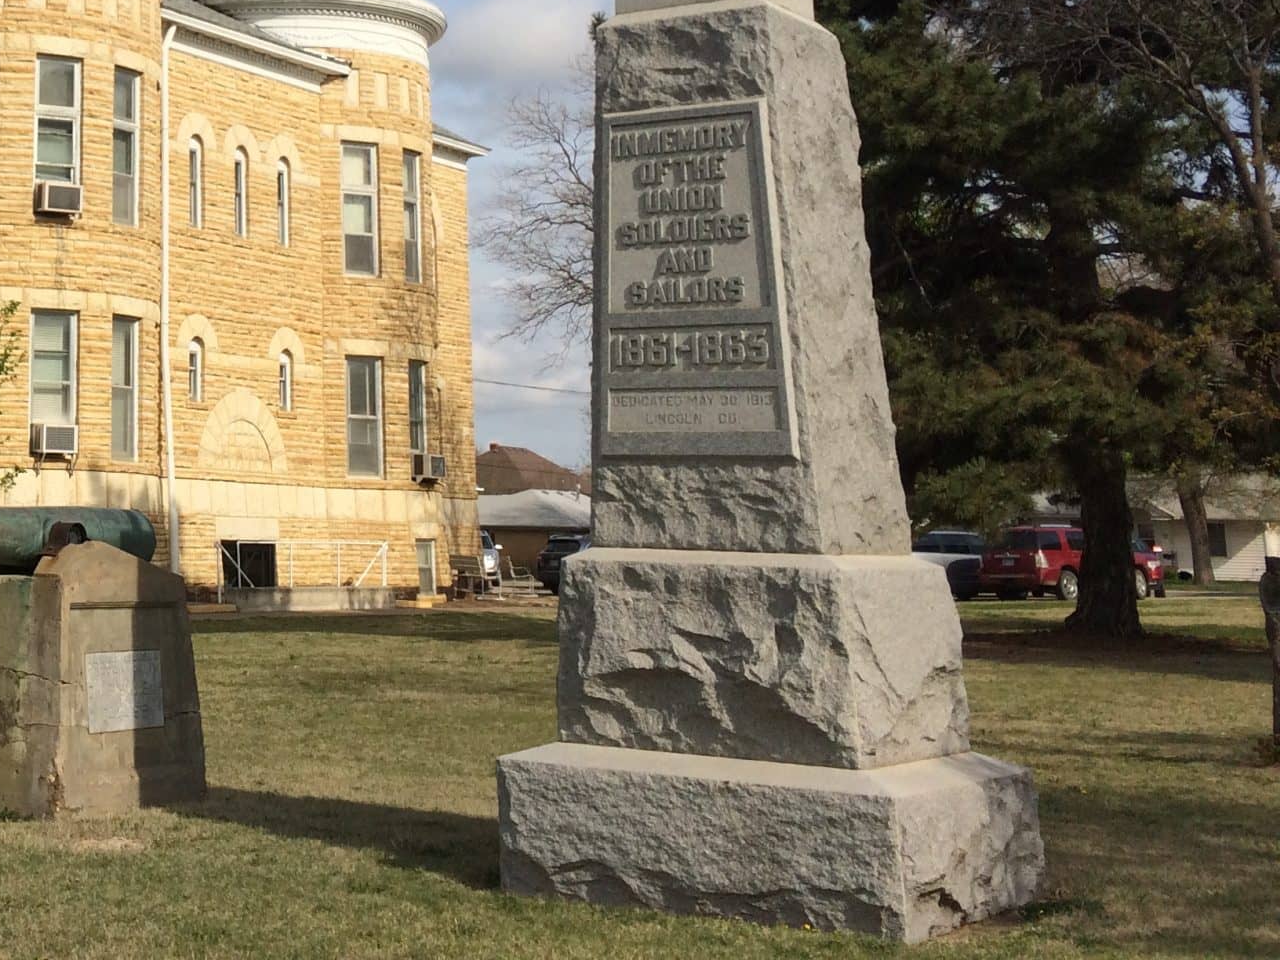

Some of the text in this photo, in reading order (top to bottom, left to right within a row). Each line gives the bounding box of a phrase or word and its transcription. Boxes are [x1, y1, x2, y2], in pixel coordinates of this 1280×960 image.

[613, 120, 751, 157] IN MEMORY
[640, 153, 726, 185] OF THE
[644, 184, 724, 213] UNION
[619, 212, 751, 246] SOLDIERS
[660, 246, 715, 274] AND
[631, 276, 746, 305] SAILORS
[615, 329, 770, 367] 1861-1865
[613, 395, 682, 408] DEDICATED
[687, 394, 713, 408] MAY
[646, 413, 702, 425] LINCOLN
